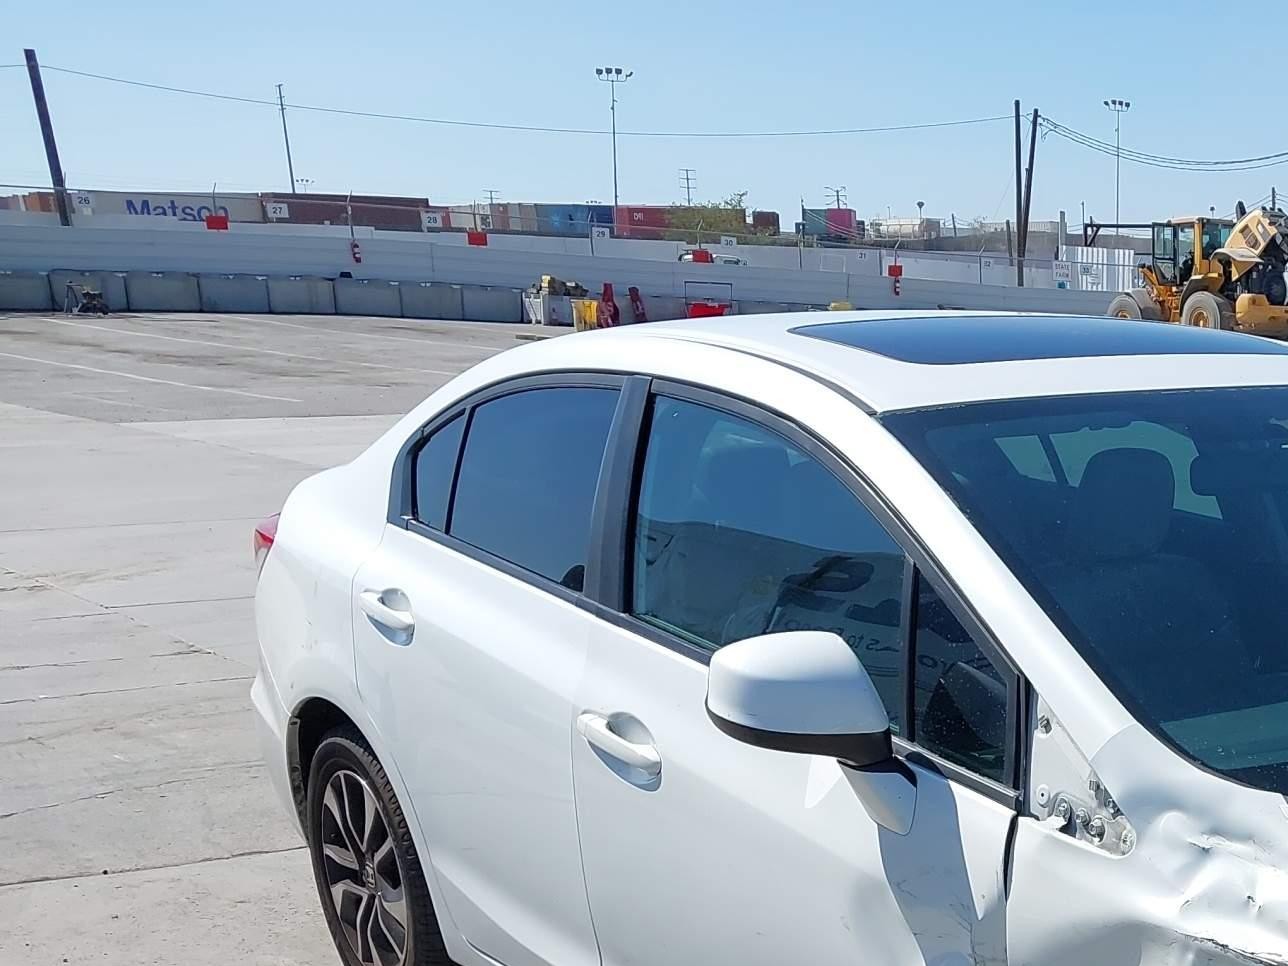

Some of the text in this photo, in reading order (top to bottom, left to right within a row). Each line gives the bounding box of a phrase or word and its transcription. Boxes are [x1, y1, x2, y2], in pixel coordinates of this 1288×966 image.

[77, 196, 90, 205] 26
[125, 199, 228, 222] Matson
[271, 206, 283, 215] 27
[427, 216, 437, 224] 28
[596, 230, 606, 238] 29
